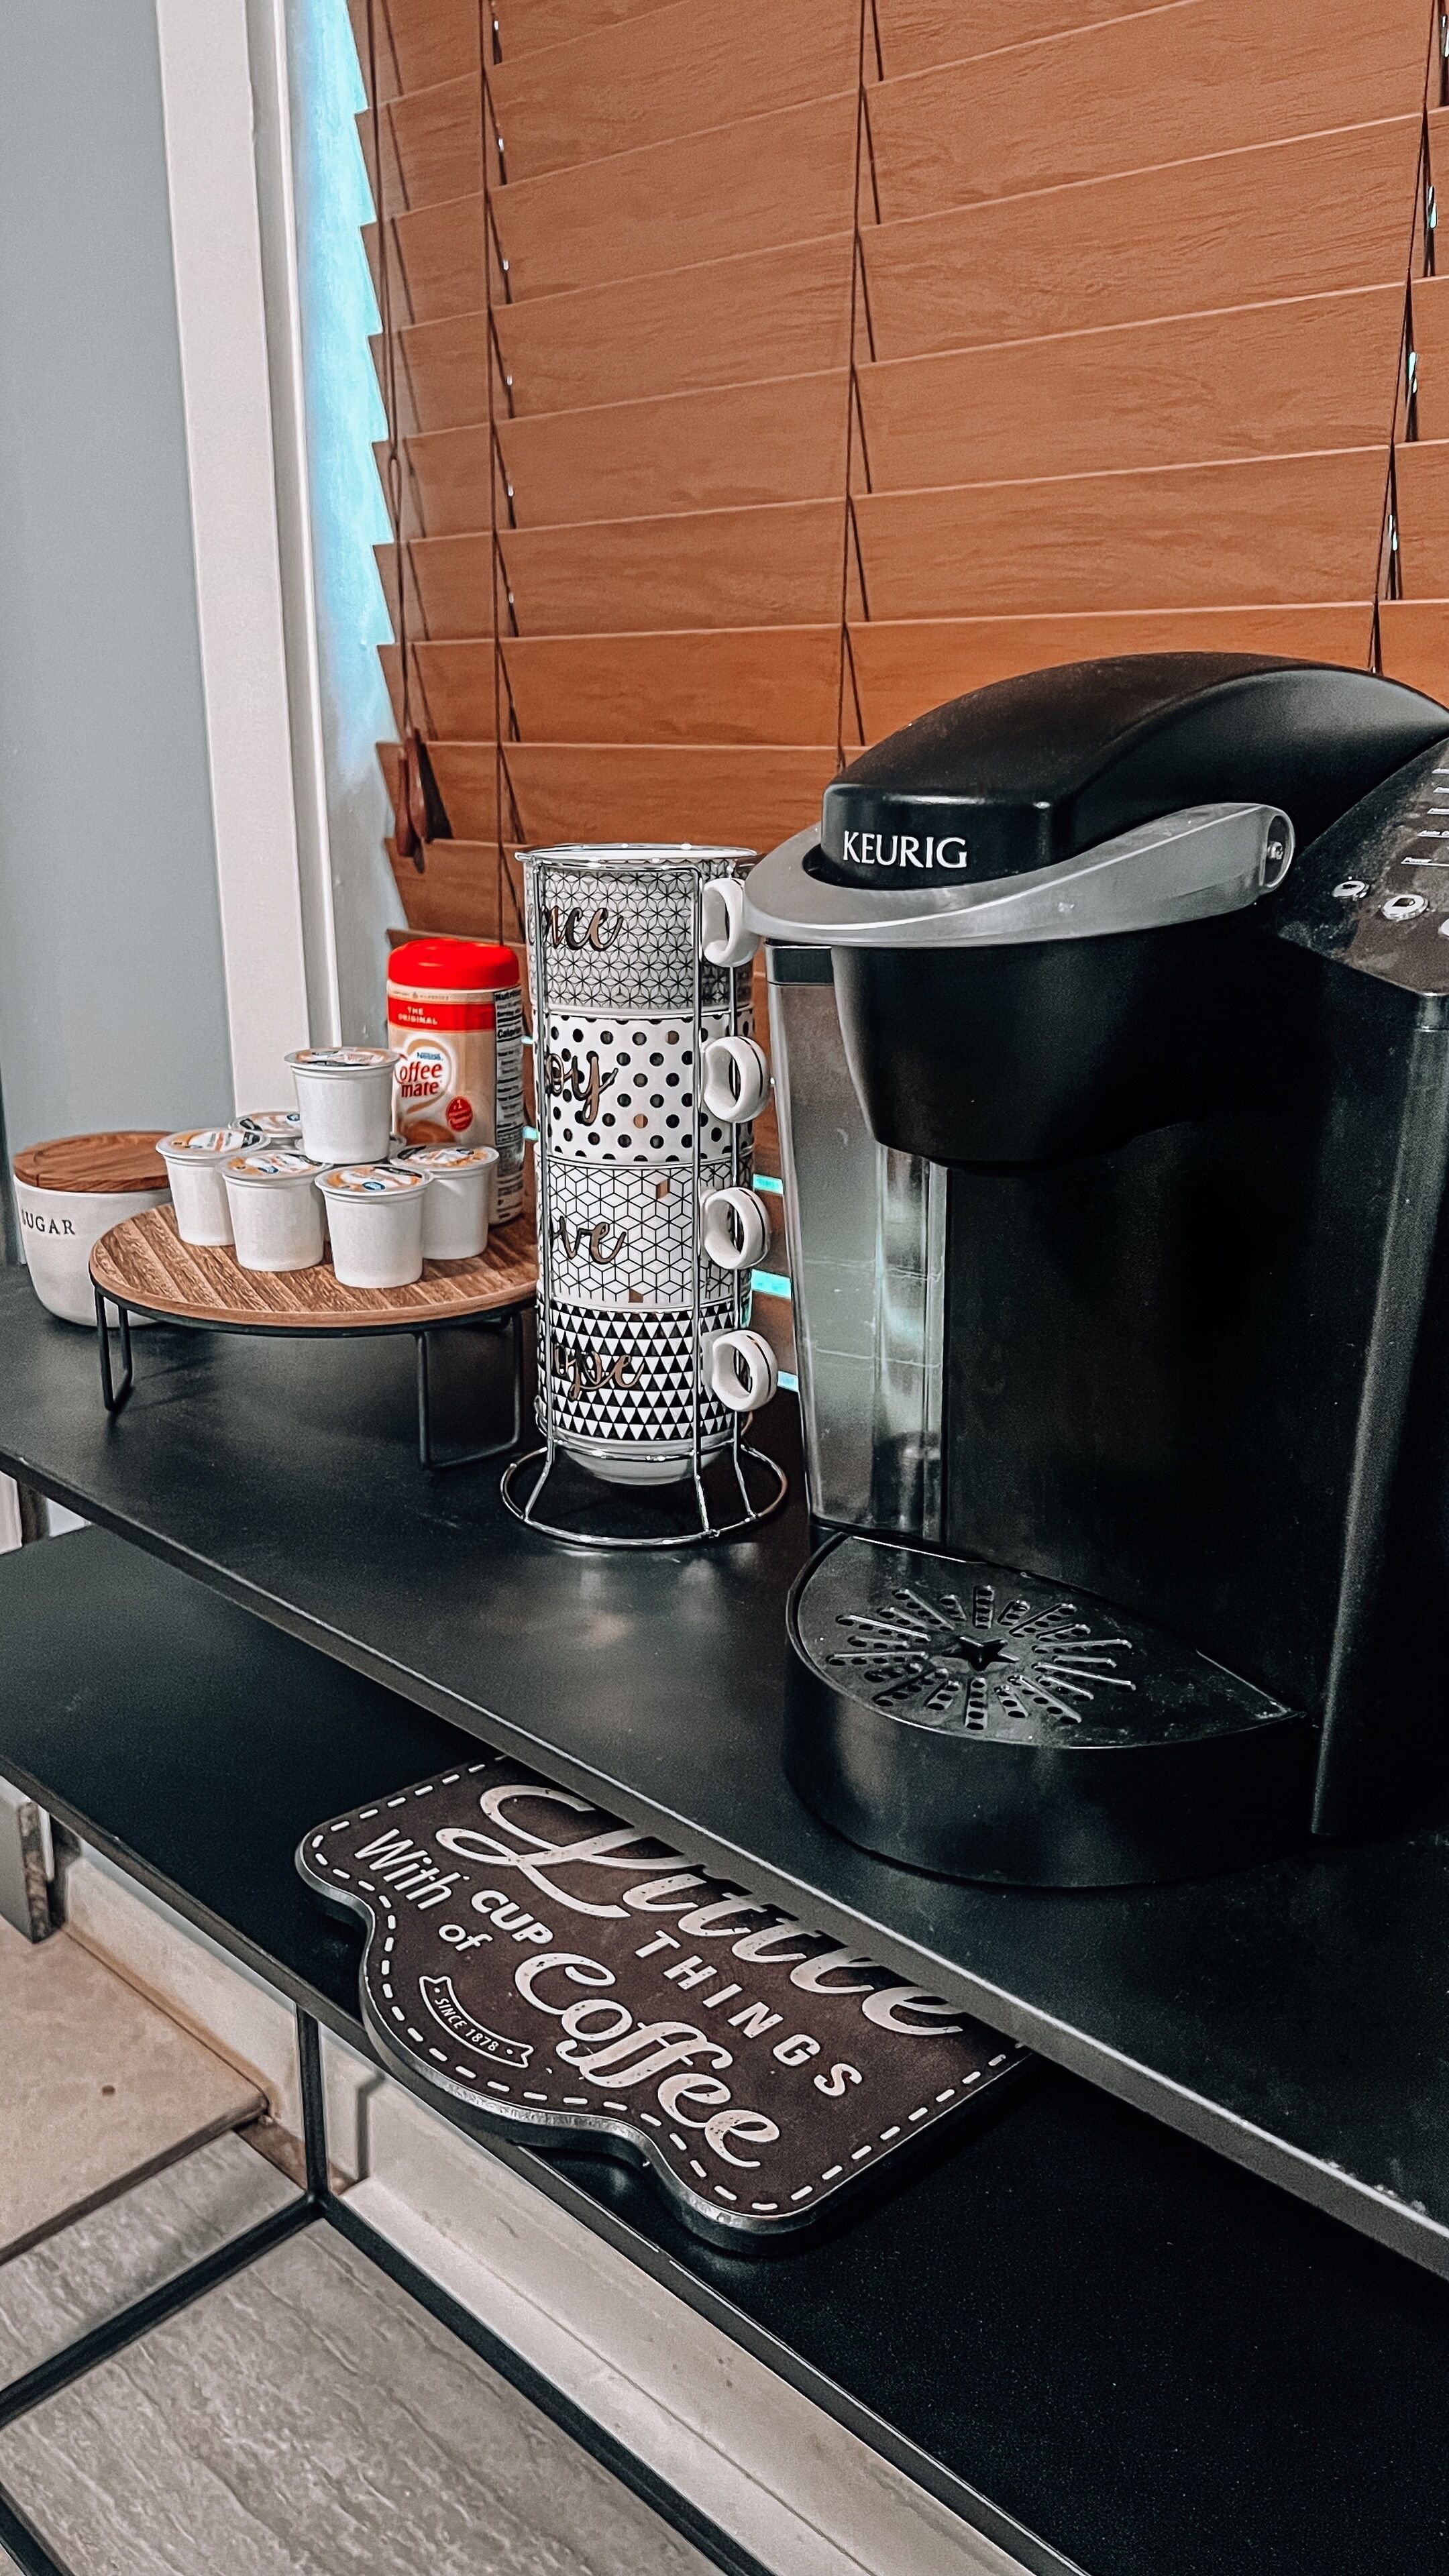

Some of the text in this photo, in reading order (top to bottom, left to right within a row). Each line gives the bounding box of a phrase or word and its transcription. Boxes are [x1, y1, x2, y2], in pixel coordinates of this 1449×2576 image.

[843, 830, 967, 868] KEURIG
[398, 1013, 438, 1025] ORIGINAL
[407, 1006, 423, 1015] THE
[401, 1081, 439, 1097] mate
[545, 1053, 619, 1127] oy
[354, 1828, 461, 1911] With
[438, 1923, 494, 1951] of
[471, 1890, 554, 1944] CUP
[435, 1998, 500, 2051] SINCE 1878
[635, 1929, 863, 2097] THINGS
[515, 1952, 780, 2167] Coffee
